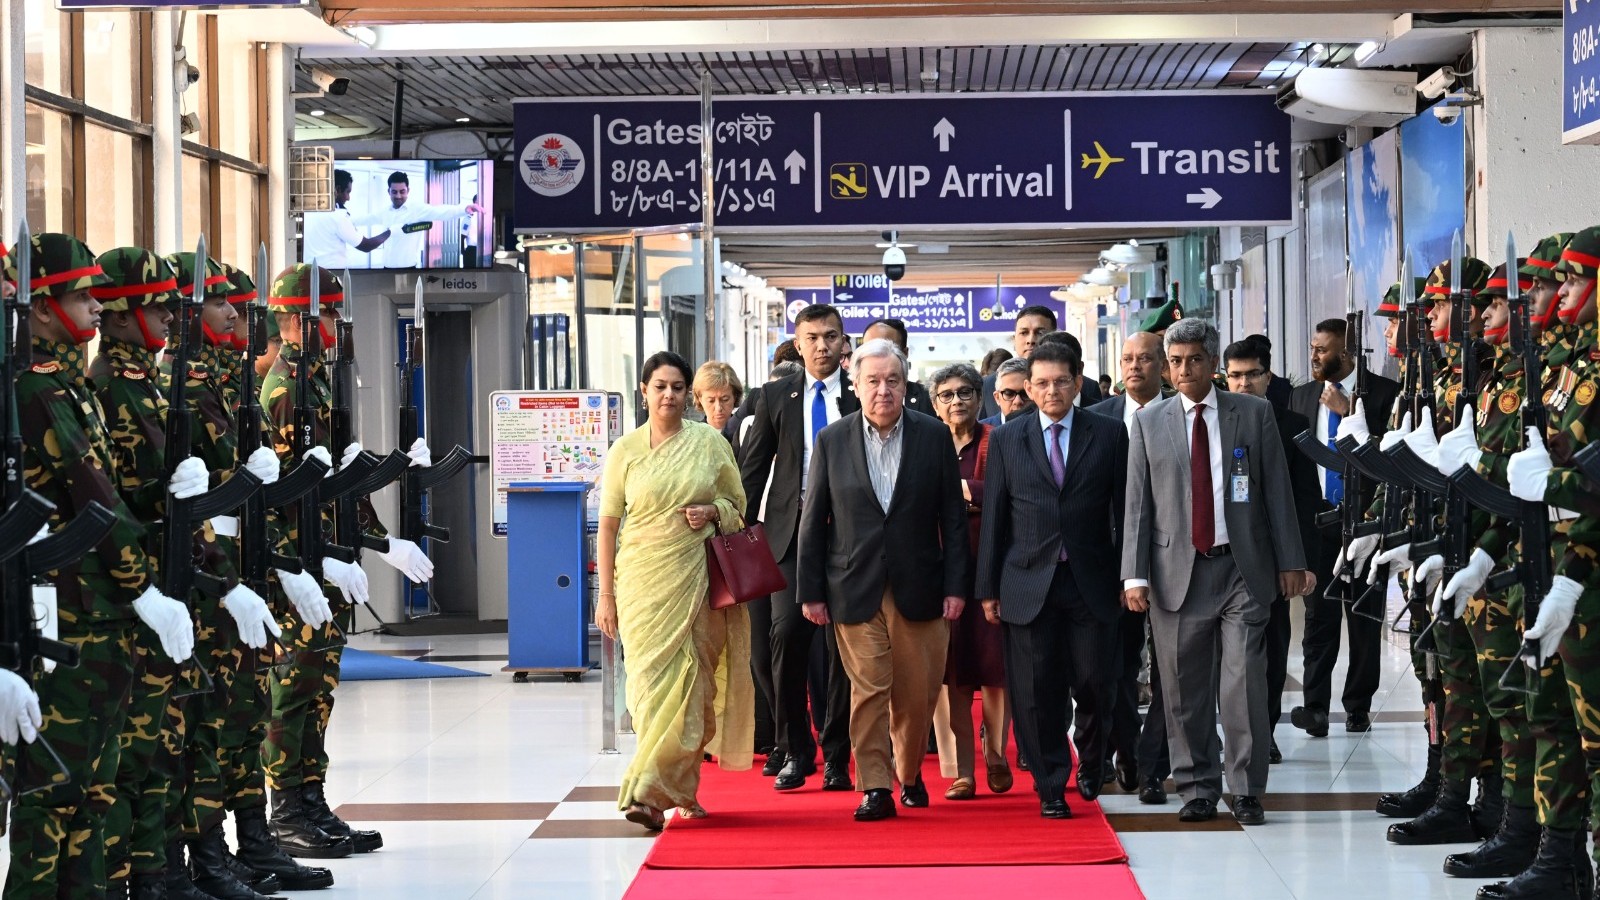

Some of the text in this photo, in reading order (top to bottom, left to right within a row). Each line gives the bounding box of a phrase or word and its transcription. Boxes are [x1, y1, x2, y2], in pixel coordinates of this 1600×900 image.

[1572, 24, 1600, 65] 8/8A-
[611, 158, 777, 183] 8/8A-1/11A
[1131, 140, 1280, 175] Transit
[872, 163, 1053, 199] VIP Arrival
[610, 184, 776, 218] ৮/৮এ-১/১১এ
[442, 278, 477, 289] leidos
[836, 306, 869, 318] Toilet
[890, 307, 966, 317] 9/9A-11/11A
